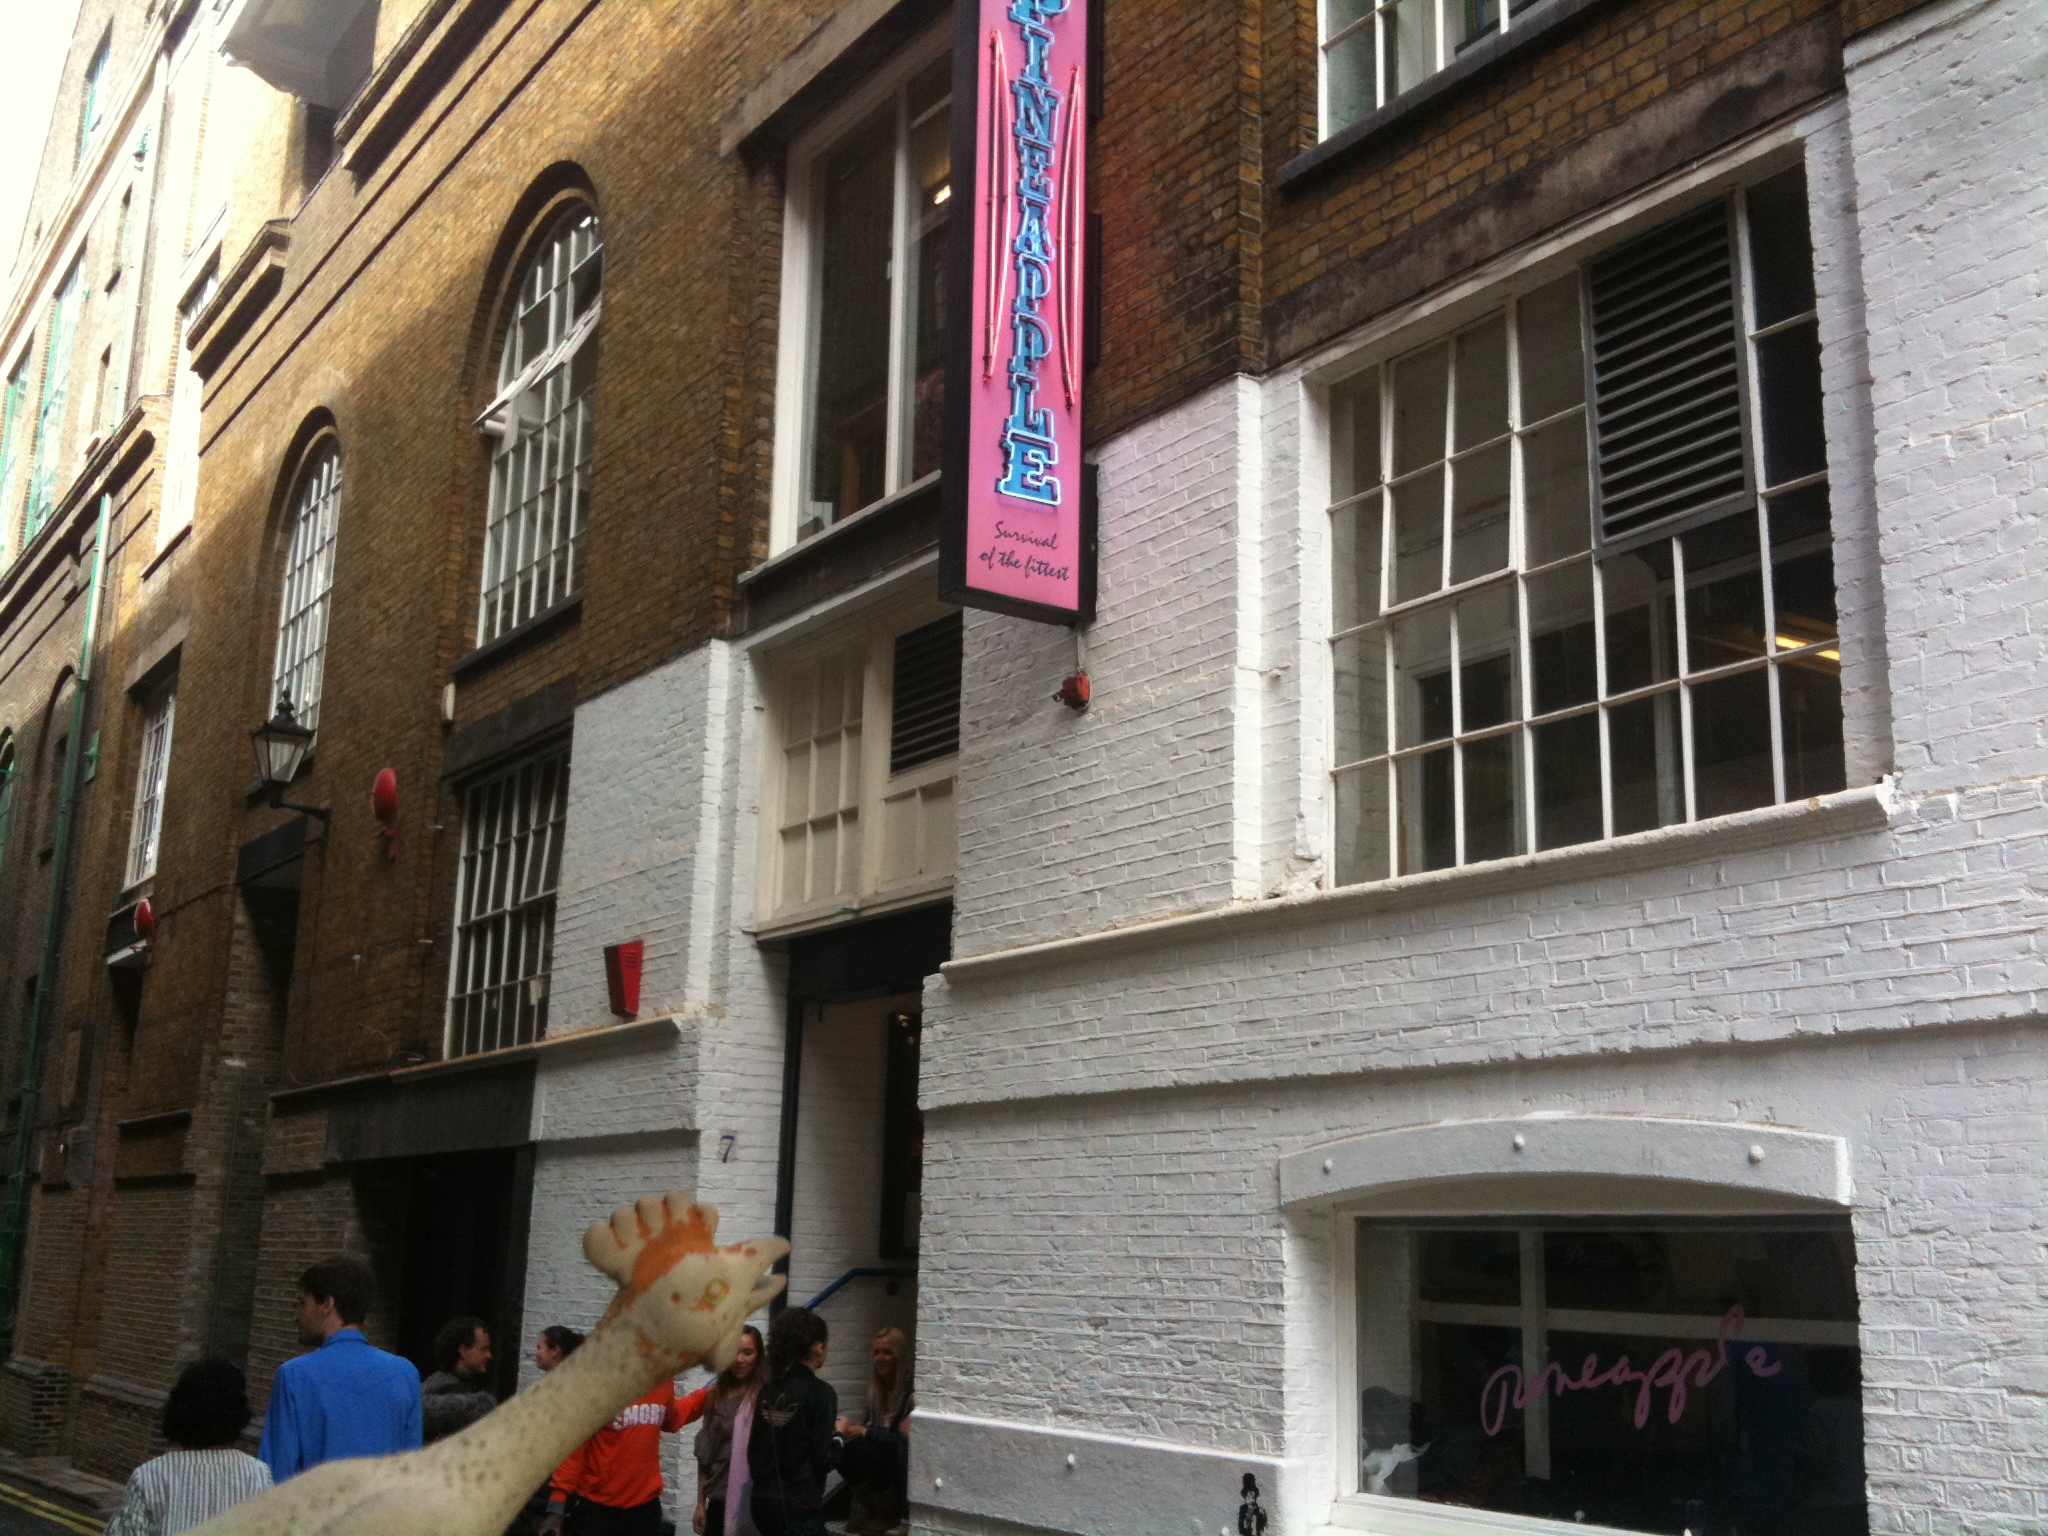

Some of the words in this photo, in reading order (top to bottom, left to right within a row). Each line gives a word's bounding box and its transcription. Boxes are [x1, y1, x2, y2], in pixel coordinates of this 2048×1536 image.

[994, 520, 1058, 550] Survival
[978, 546, 996, 570] of
[998, 550, 1021, 569] the
[1024, 555, 1069, 581] fittest
[719, 1135, 735, 1163] 7
